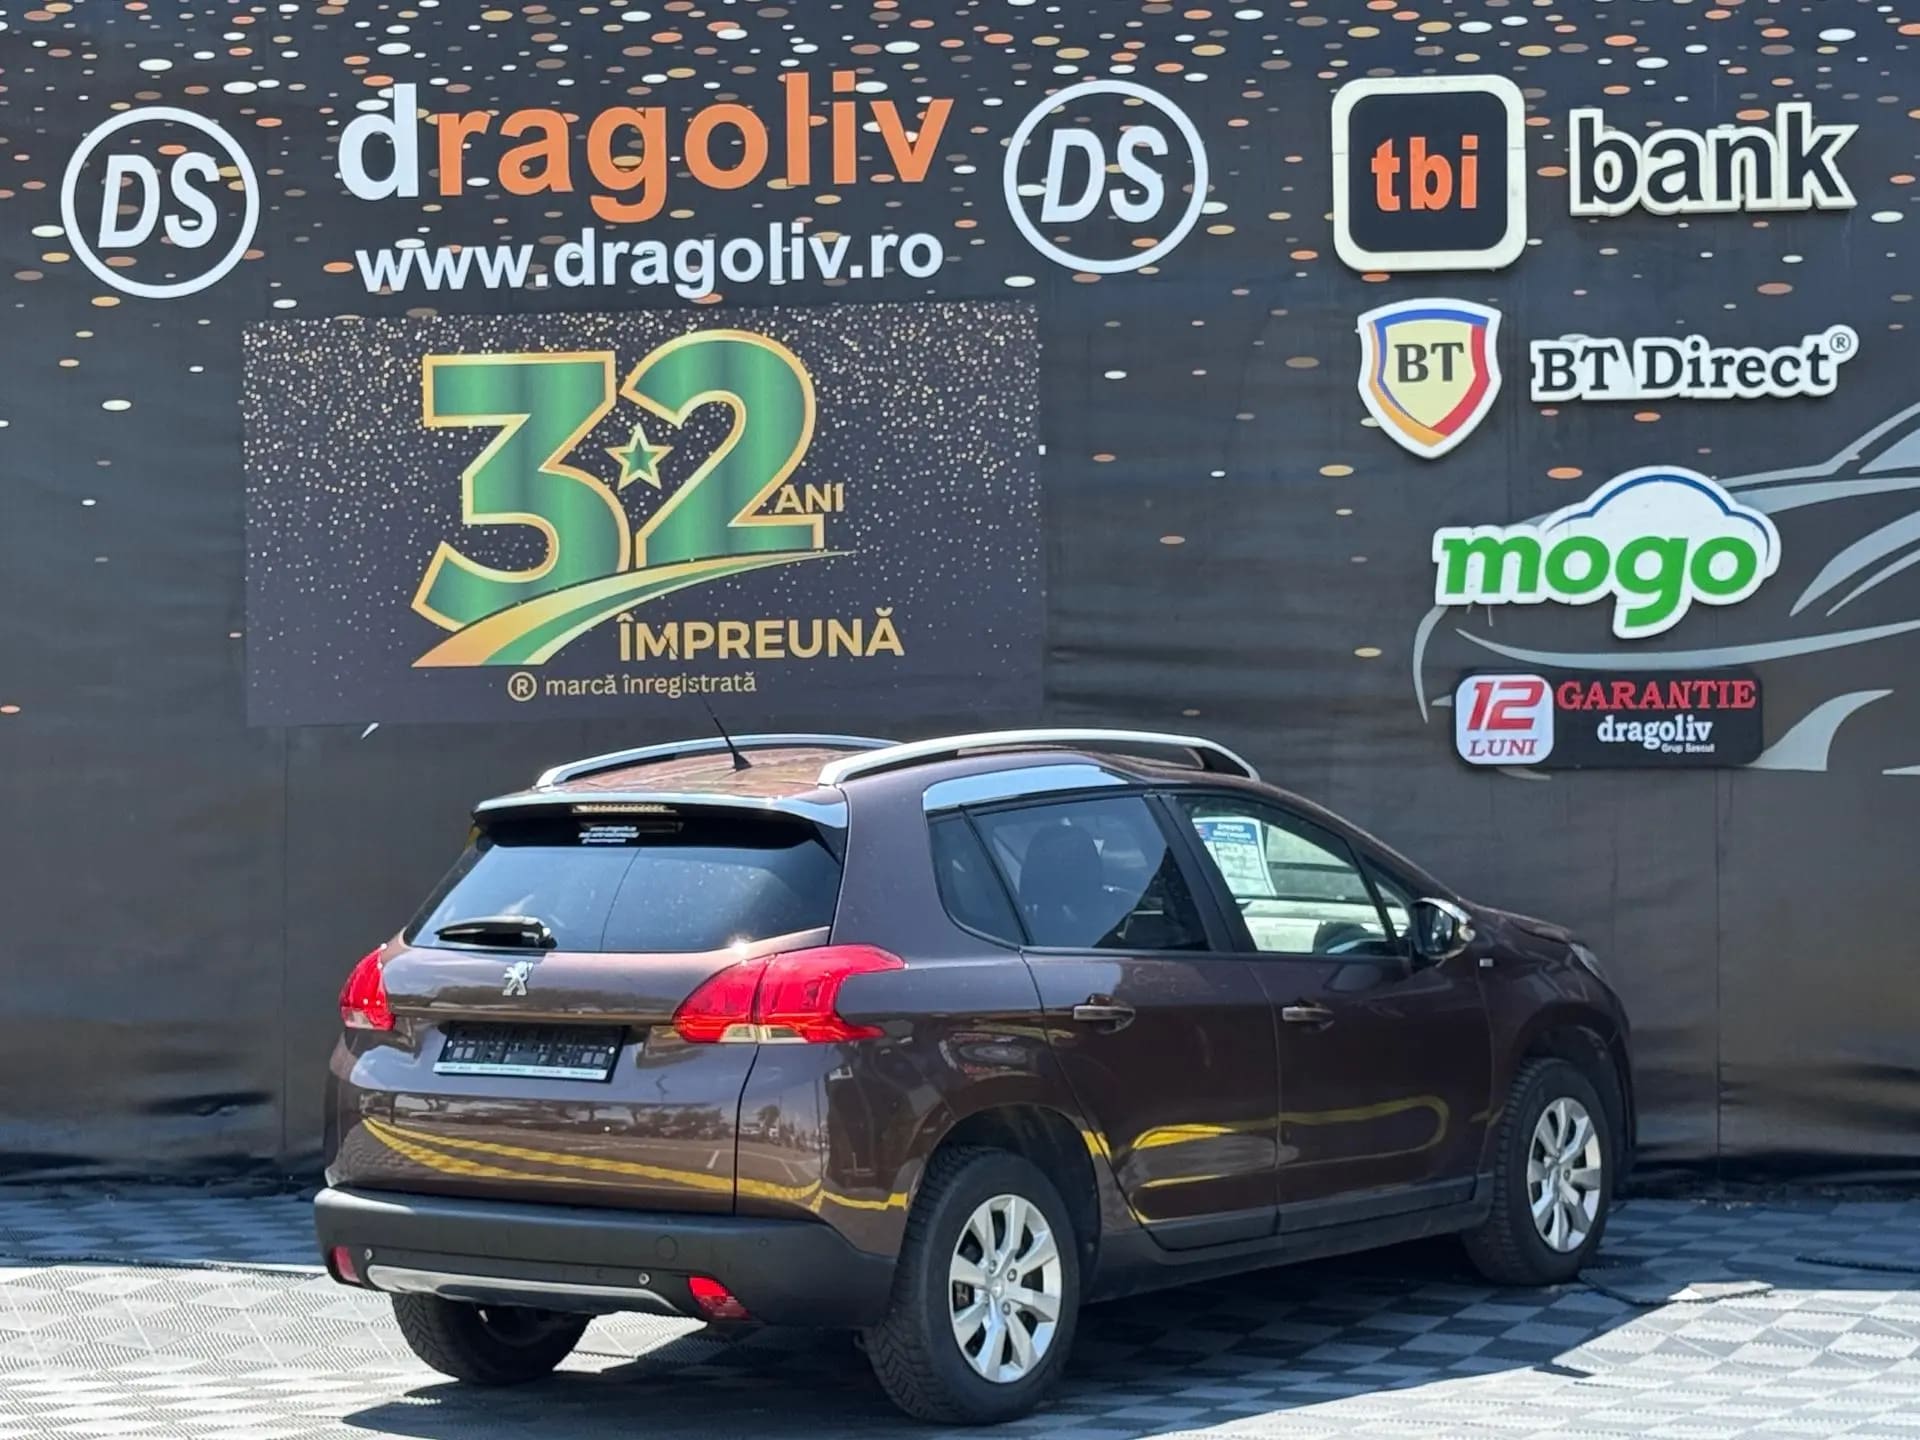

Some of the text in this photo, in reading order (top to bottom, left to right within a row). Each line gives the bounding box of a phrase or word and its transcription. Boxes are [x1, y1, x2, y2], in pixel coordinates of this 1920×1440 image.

[338, 71, 954, 223] dragoliv
[1040, 125, 1168, 223] DS
[1371, 134, 1480, 213] tbi
[1570, 103, 1858, 216] bank
[97, 152, 220, 248] DS
[355, 222, 944, 300] www.dragoliv.ro
[1397, 342, 1465, 384] BT
[1537, 343, 1621, 393] BT
[411, 328, 824, 632] 32
[775, 482, 845, 514] ANI
[1441, 535, 1758, 628] mogo
[615, 606, 905, 662] ÎMPREUNĂ
[545, 673, 618, 696] marcă
[623, 671, 757, 699] înregistrată
[1467, 681, 1545, 731] 12
[1556, 680, 1757, 711] GARANTIE
[1468, 738, 1538, 758] LUNI
[1597, 715, 1713, 750] dragoliv
